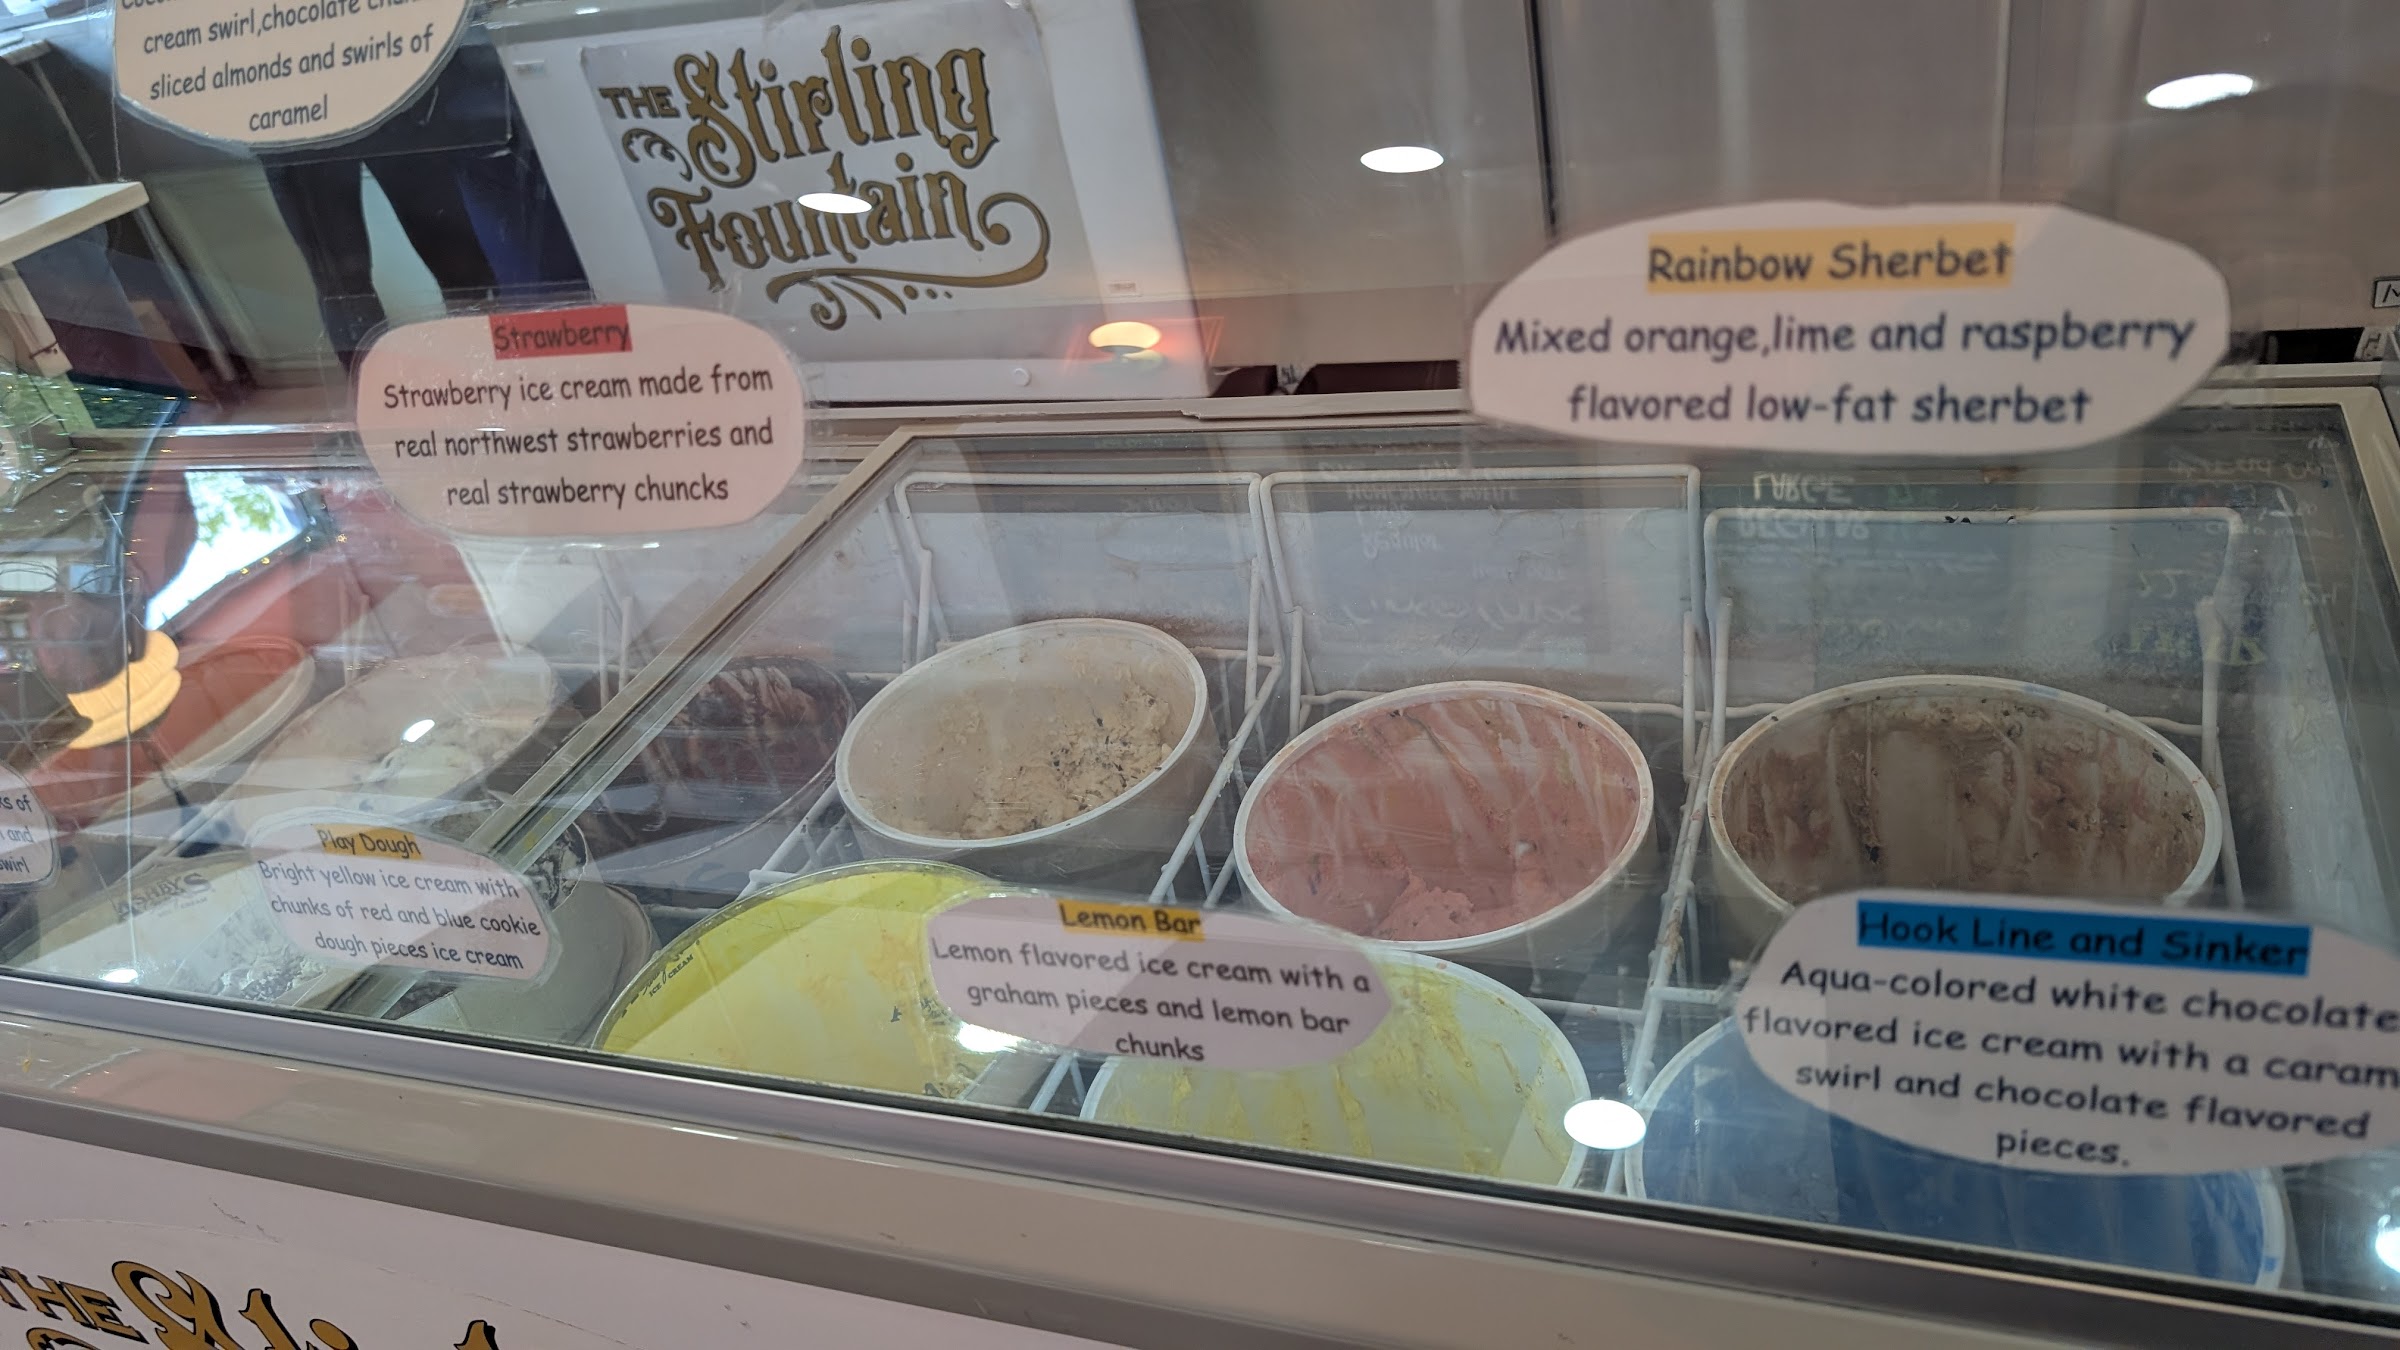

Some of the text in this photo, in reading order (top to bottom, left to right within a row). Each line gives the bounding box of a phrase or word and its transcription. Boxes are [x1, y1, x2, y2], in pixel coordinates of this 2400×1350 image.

[144, 26, 202, 54] cream
[150, 23, 434, 100] sliced almonds and swirls of
[249, 96, 329, 132] caramel
[600, 24, 999, 188] THE Stirling
[647, 151, 985, 291] Fountain
[1648, 239, 2013, 284] Rainbow Sherbet
[493, 321, 631, 352] Strawberry
[1494, 318, 1612, 356] Mixed
[1870, 312, 1948, 353] and
[1961, 313, 2196, 361] raspberry
[383, 363, 774, 411] Strawberry ice cream made from
[1568, 384, 2091, 425] flavored low-fat sherbet
[394, 417, 774, 459] real northwest strawberries and
[447, 473, 729, 510] real strawberry chuncks
[16, 794, 32, 813] of
[7, 825, 34, 843] and
[317, 828, 421, 859] Play Dough
[258, 860, 520, 898] Bright yellow ice cream with
[271, 894, 541, 936] chunks of red and blue cookie
[1059, 903, 1203, 934] Lemon Bar
[315, 931, 525, 970] dough pieces ice cream
[1858, 910, 2309, 968] Hook Line and Sinker
[667, 954, 694, 979] CREAM
[931, 938, 1371, 994] Lemon flavored ice cream with a
[967, 982, 1351, 1034] graham pieces and lemon bar
[1780, 959, 2400, 1034] Aqua-colored white chocolate
[1115, 1033, 1205, 1062] chunks
[1742, 1006, 1898, 1045] flavored
[1911, 1019, 1967, 1051] ice
[1980, 1033, 2104, 1063] cream
[2117, 1035, 2209, 1072] with
[2223, 1051, 2249, 1077] a
[1795, 1063, 2371, 1141] swirl and chocolate flavored
[1994, 1128, 2131, 1168] pieces.
